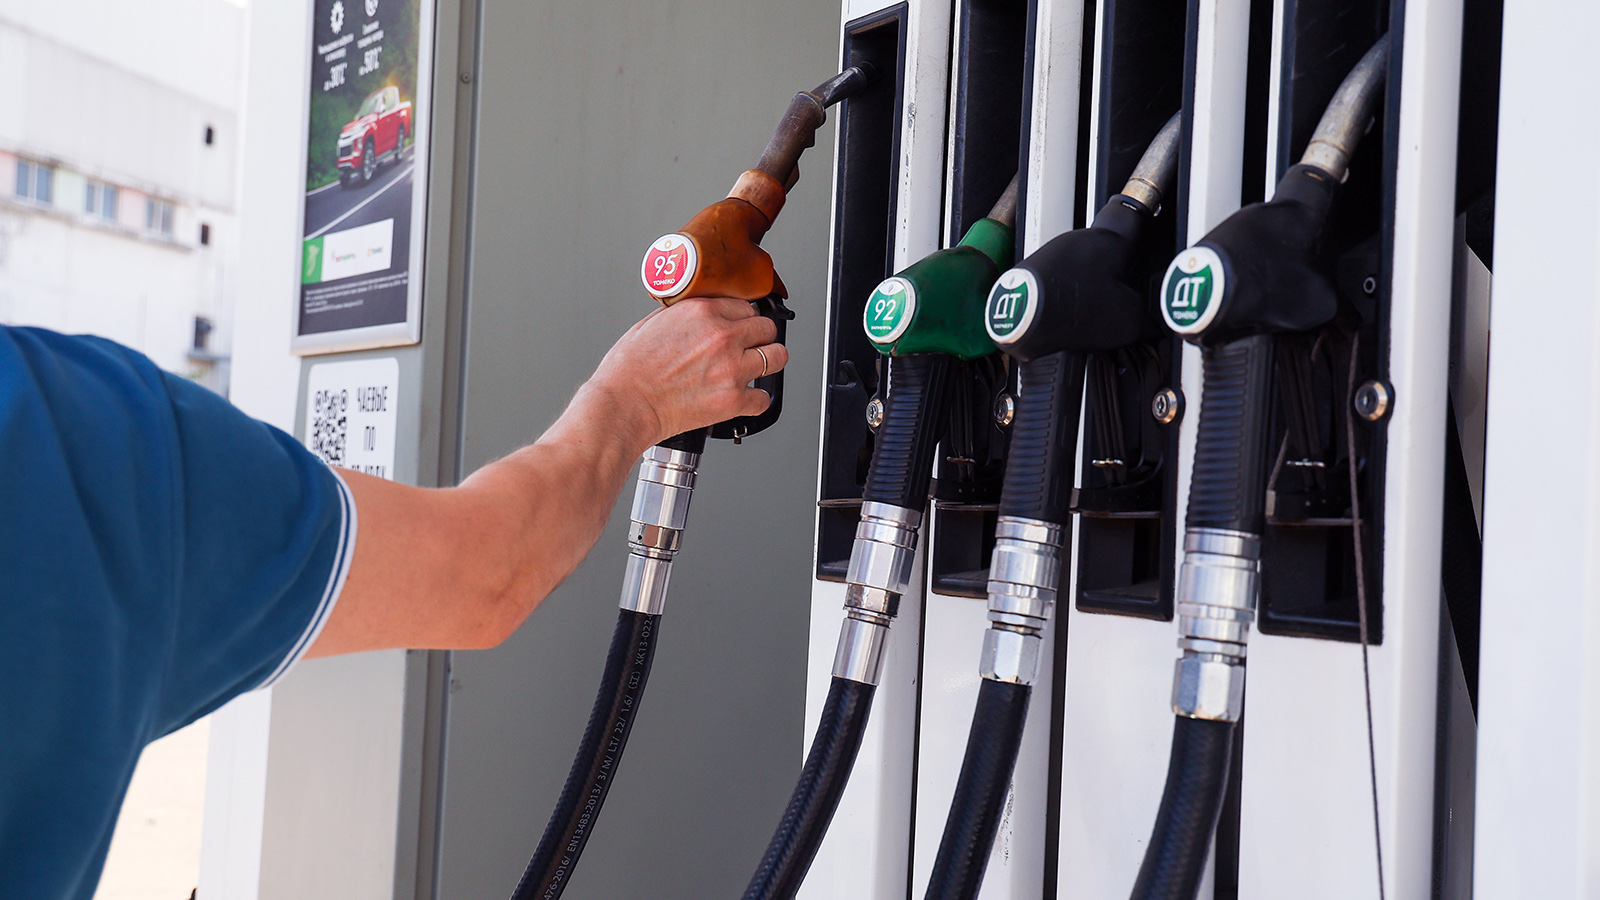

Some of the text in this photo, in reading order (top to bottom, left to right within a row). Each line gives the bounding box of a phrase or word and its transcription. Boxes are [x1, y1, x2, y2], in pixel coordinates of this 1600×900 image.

[654, 253, 679, 277] 95
[1171, 276, 1206, 308] ДТ
[874, 299, 897, 321] 92
[993, 292, 1022, 319] ДТ
[357, 386, 389, 412] ЧАЕВЫЕ
[363, 426, 377, 452] ПО
[614, 716, 627, 734] 22/
